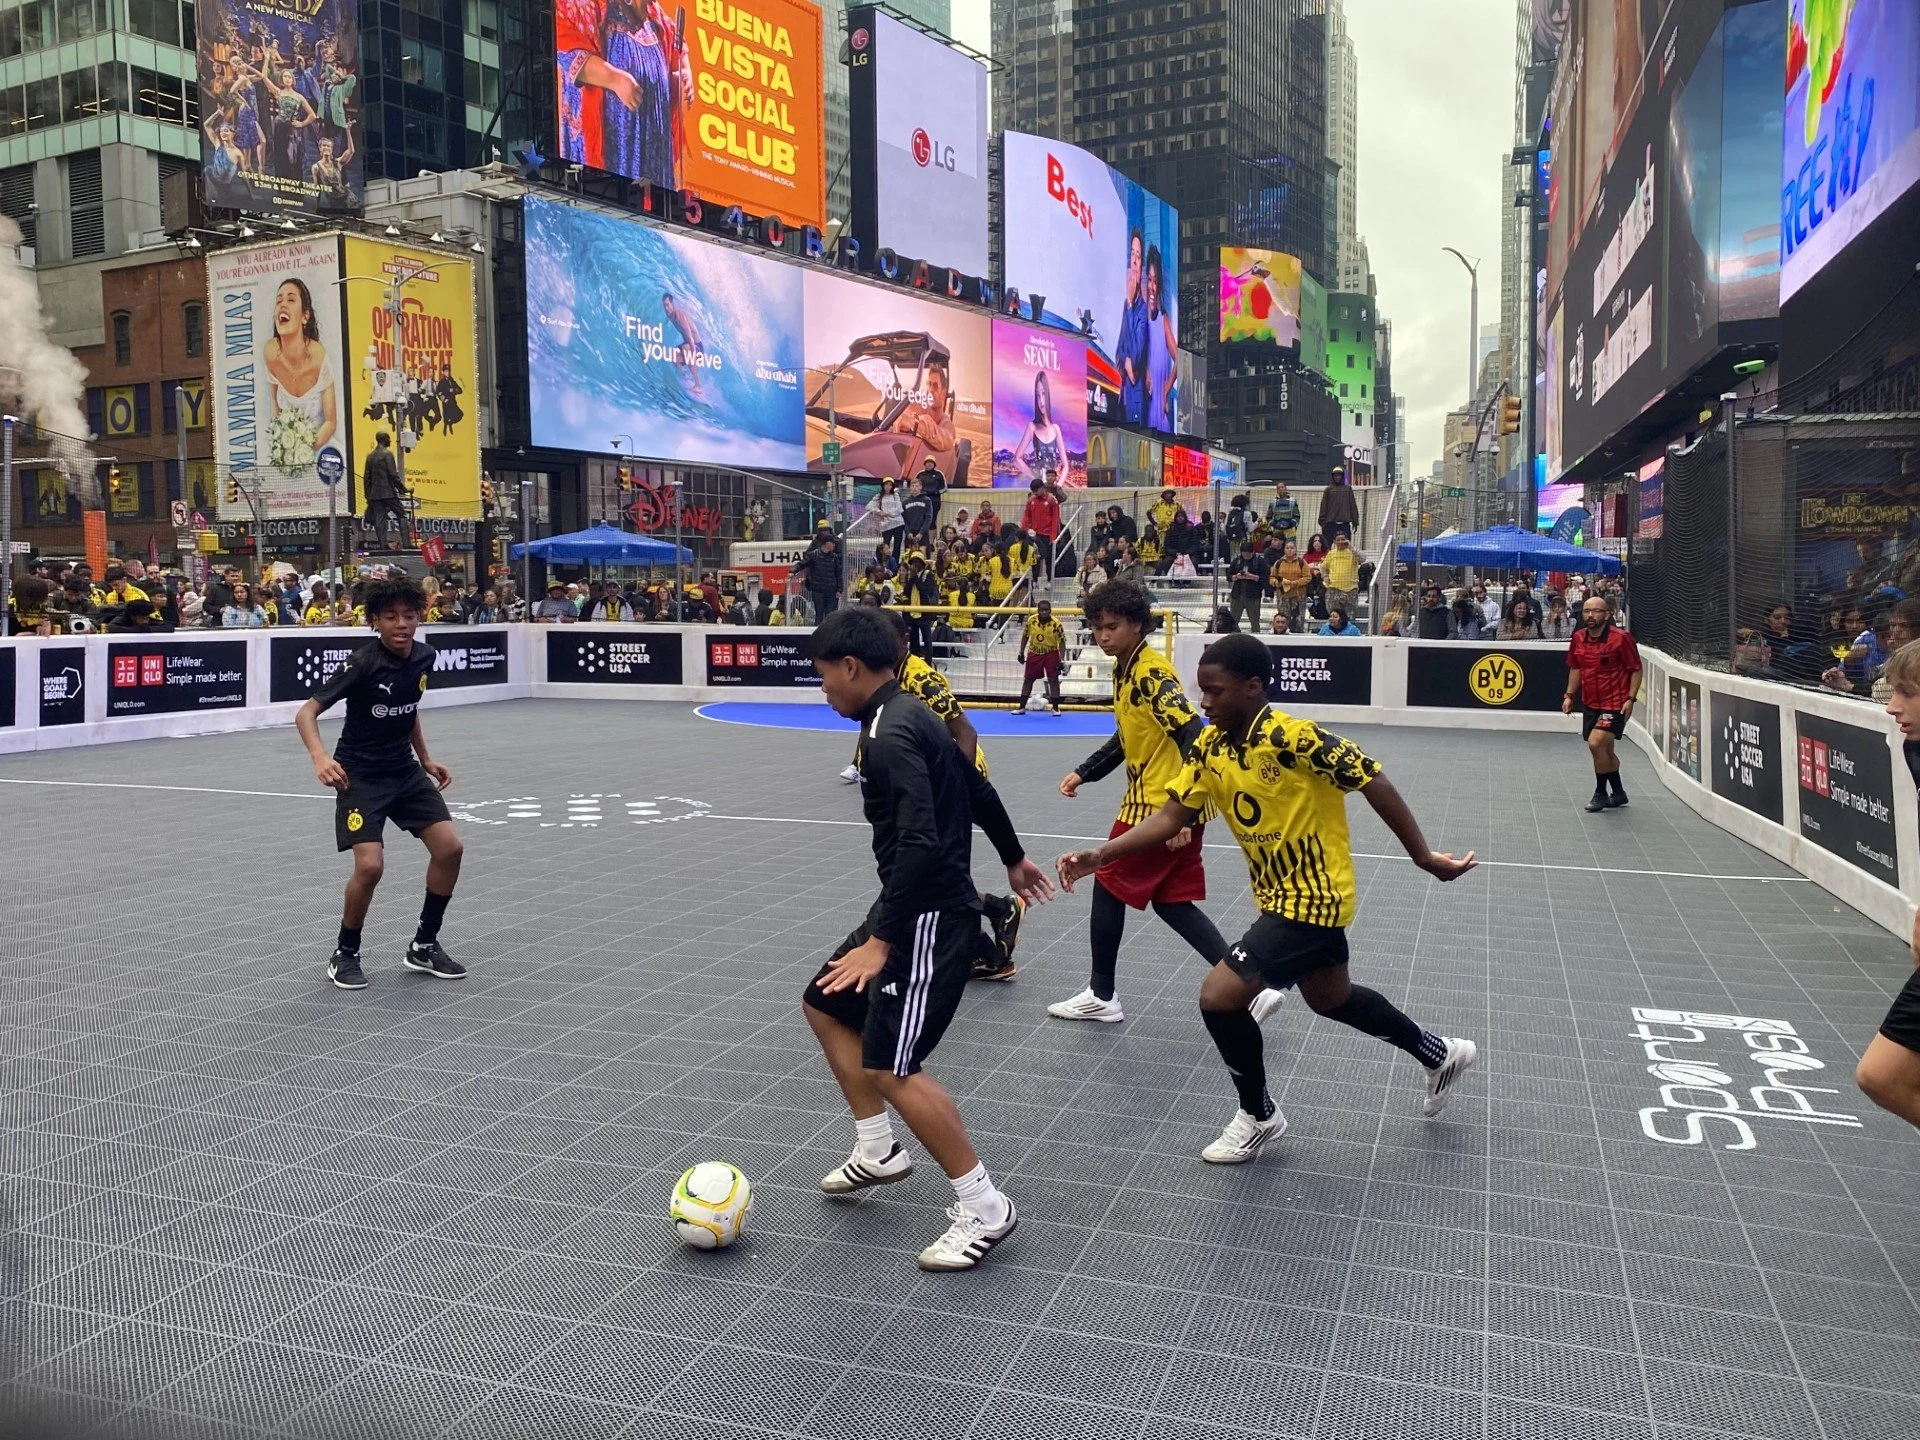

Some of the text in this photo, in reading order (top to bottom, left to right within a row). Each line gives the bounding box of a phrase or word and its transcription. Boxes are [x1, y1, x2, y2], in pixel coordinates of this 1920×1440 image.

[245, 2, 252, 10] A
[254, 4, 274, 15] NEW
[275, 8, 313, 25] MUSICAL
[696, 0, 793, 58] BUENA
[697, 27, 794, 98] VISTA
[852, 53, 868, 66] LG
[698, 72, 795, 134] SOCIAL
[699, 113, 796, 175] CLUB
[934, 141, 955, 172] LG
[701, 150, 713, 161] THE
[714, 155, 729, 165] TONY
[774, 176, 796, 189] MUSICAL
[260, 174, 300, 187] BROADWAY
[301, 181, 333, 193] THEATRE
[281, 185, 320, 198] BROADWAY
[1046, 152, 1093, 240] Best
[643, 186, 784, 248] 1540
[236, 244, 312, 265] YOU ALREADY KNOW
[216, 267, 241, 280] YOU'RE
[243, 264, 270, 276] GONNA
[272, 260, 291, 272] LOVE
[308, 253, 336, 266] AGAIN!
[802, 224, 1046, 321] BROADWAY
[223, 291, 254, 358] MIA!
[372, 306, 453, 349] OPRATION
[625, 315, 663, 343] Find
[373, 339, 453, 381] MICEMEAT
[643, 341, 722, 370] your wave
[1024, 344, 1060, 370] SEOUL
[881, 384, 933, 409] your edge
[110, 390, 205, 431] O Y
[227, 363, 257, 473] MAMMA
[248, 520, 319, 537] LUGGAGE
[414, 519, 476, 534] LUGGAGE
[762, 552, 806, 563] U-HA
[609, 643, 646, 652] STREET
[739, 647, 754, 655] UNI
[761, 645, 799, 654] LifeWear.
[143, 660, 160, 669] UNI
[166, 656, 204, 668] LifeWear.
[432, 649, 467, 671] NYC
[609, 654, 650, 663] SOCCER
[739, 655, 755, 664] QLO
[761, 658, 812, 667] Simple made
[1281, 658, 1327, 669] STREET
[143, 672, 161, 683] QLO
[166, 671, 243, 685] Simple made better.
[609, 665, 631, 674] USA
[1281, 670, 1331, 681] SOCCER
[1477, 660, 1517, 689] BVB
[44, 691, 67, 699] BEGIN.
[1281, 682, 1307, 692] USA
[1489, 689, 1503, 699] 09
[114, 701, 145, 709] UNIQLO.com
[1740, 722, 1760, 745] STREET
[1327, 738, 1353, 766] plu
[1344, 752, 1356, 764] tv
[1740, 746, 1763, 769] SOCCER
[1815, 747, 1827, 769] UNI
[1829, 748, 1856, 776] LifeWear.
[1261, 762, 1281, 779] BVB
[1741, 768, 1754, 787] USA
[1815, 769, 1828, 789] QLO
[1830, 780, 1891, 824] Simple made better.
